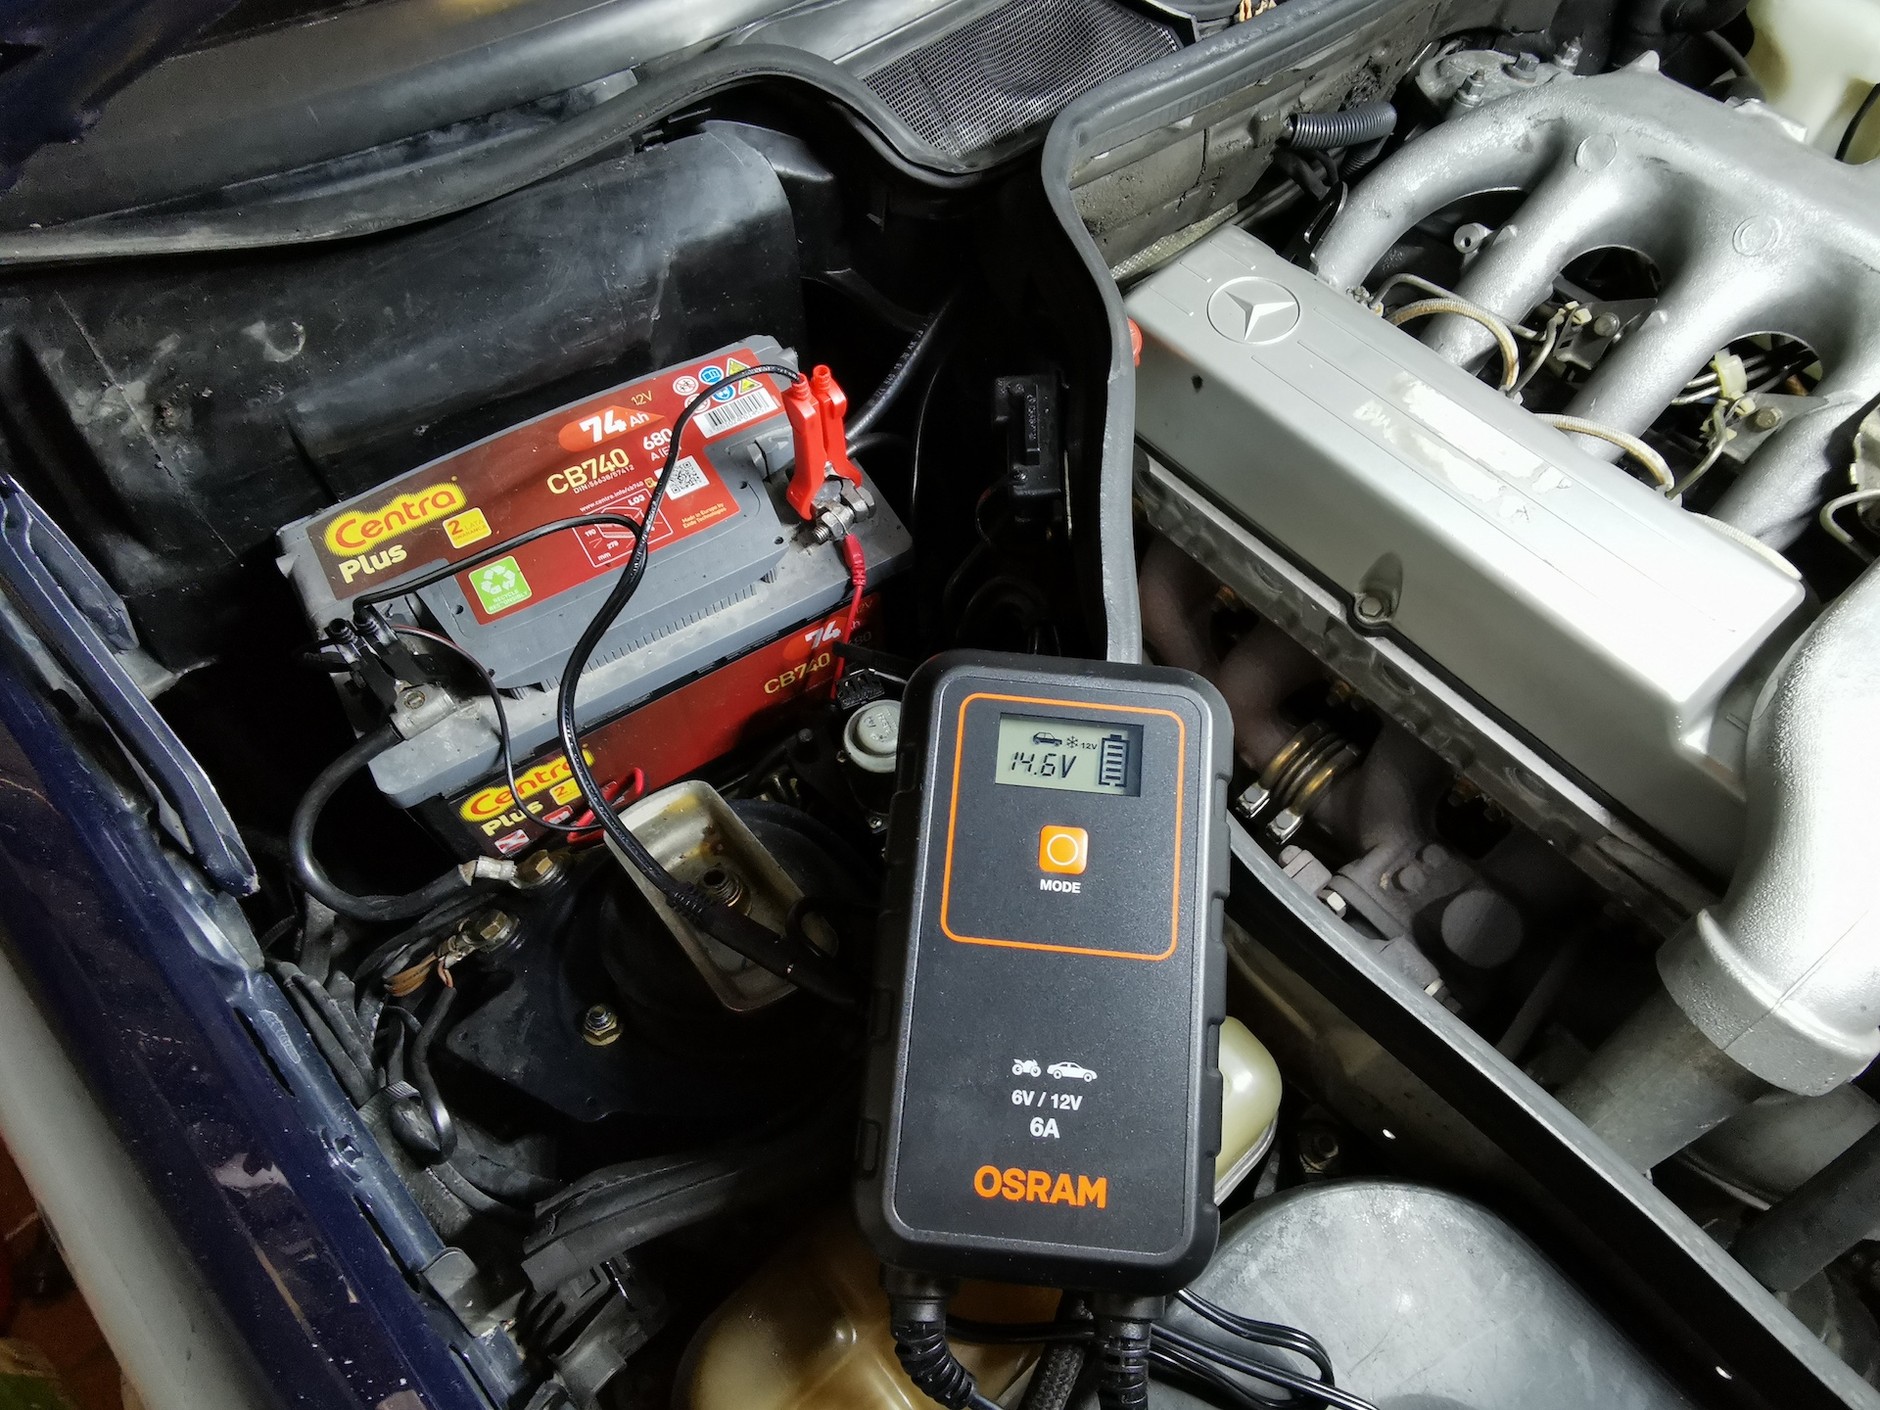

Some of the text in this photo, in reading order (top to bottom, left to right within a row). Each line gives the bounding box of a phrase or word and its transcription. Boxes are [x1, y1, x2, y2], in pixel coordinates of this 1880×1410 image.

[630, 391, 653, 406] 12V
[579, 410, 650, 443] 74 Ah
[642, 428, 673, 451] 680
[546, 448, 630, 496] CB740
[335, 486, 457, 550] Centra
[445, 519, 463, 536] 2
[338, 544, 409, 585] Plus
[804, 620, 841, 648] 74
[764, 652, 830, 694] CB740
[1080, 742, 1098, 750] 12V
[1010, 751, 1077, 779] 14.6V
[480, 801, 544, 837] Plus
[1039, 878, 1081, 894] MODE
[1011, 1089, 1083, 1111] 6V / 12V
[1029, 1117, 1060, 1139] 6A
[974, 1165, 1107, 1209] OSRAM
